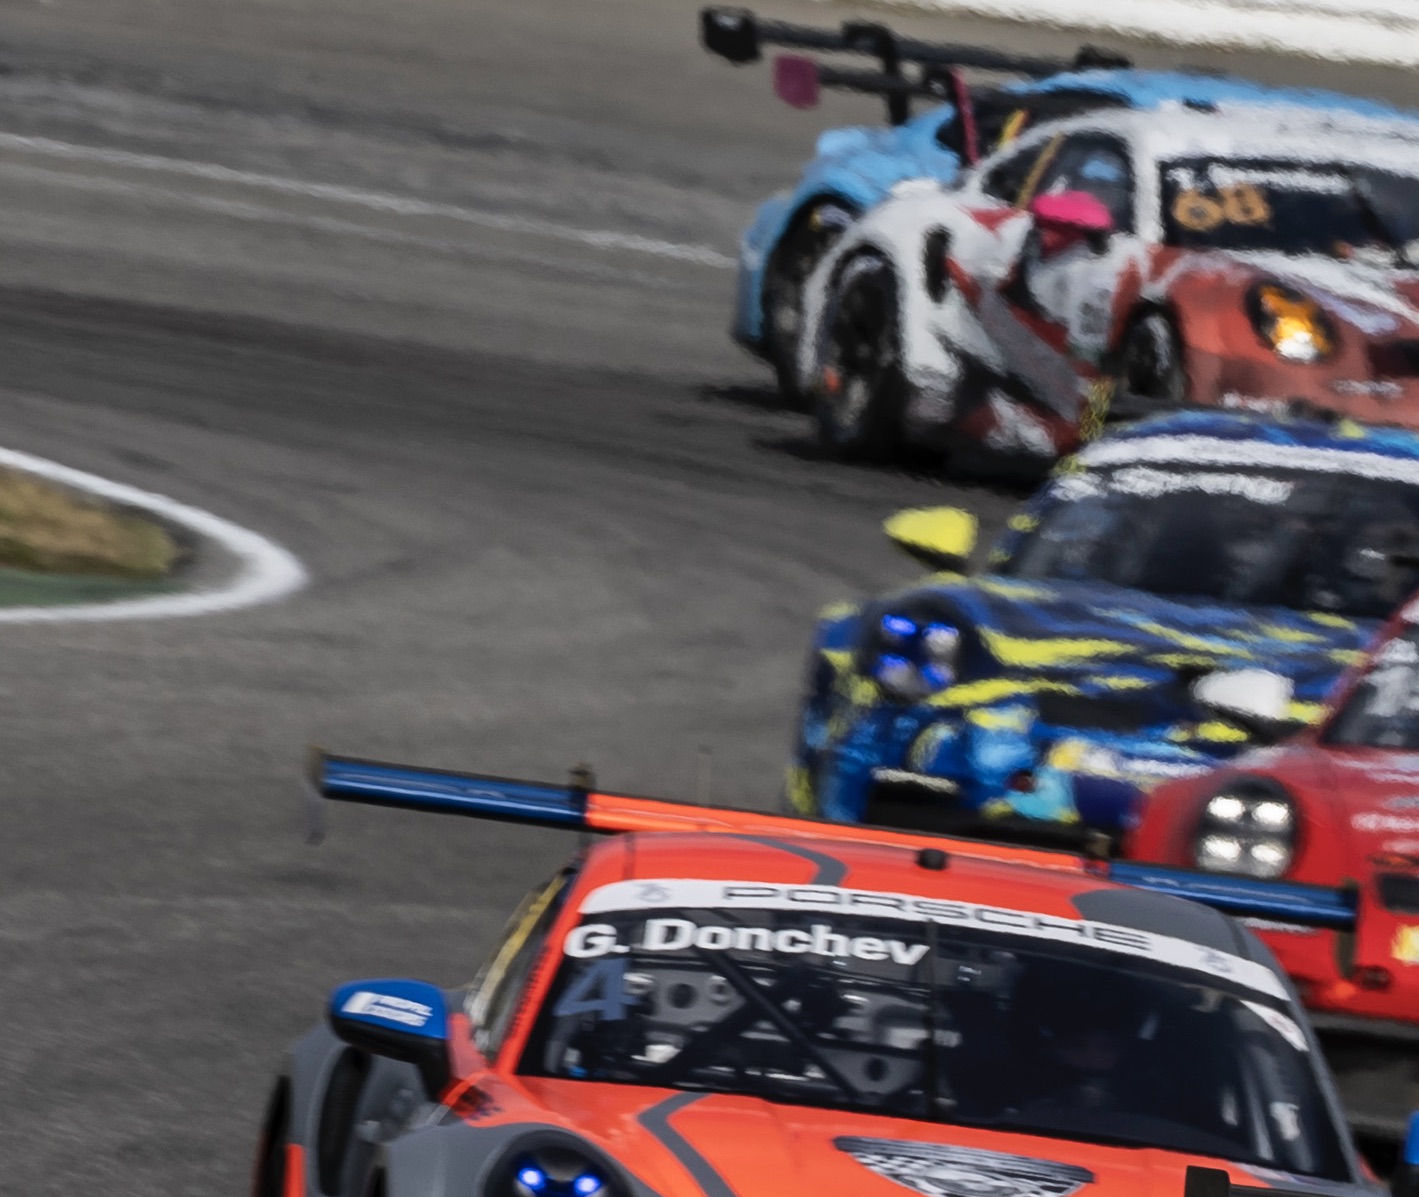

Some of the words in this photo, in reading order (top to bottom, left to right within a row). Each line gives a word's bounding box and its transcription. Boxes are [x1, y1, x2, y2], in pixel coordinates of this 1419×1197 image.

[564, 922, 630, 959] G.
[643, 918, 930, 966] Donchev
[723, 886, 1154, 951] PORSCHE
